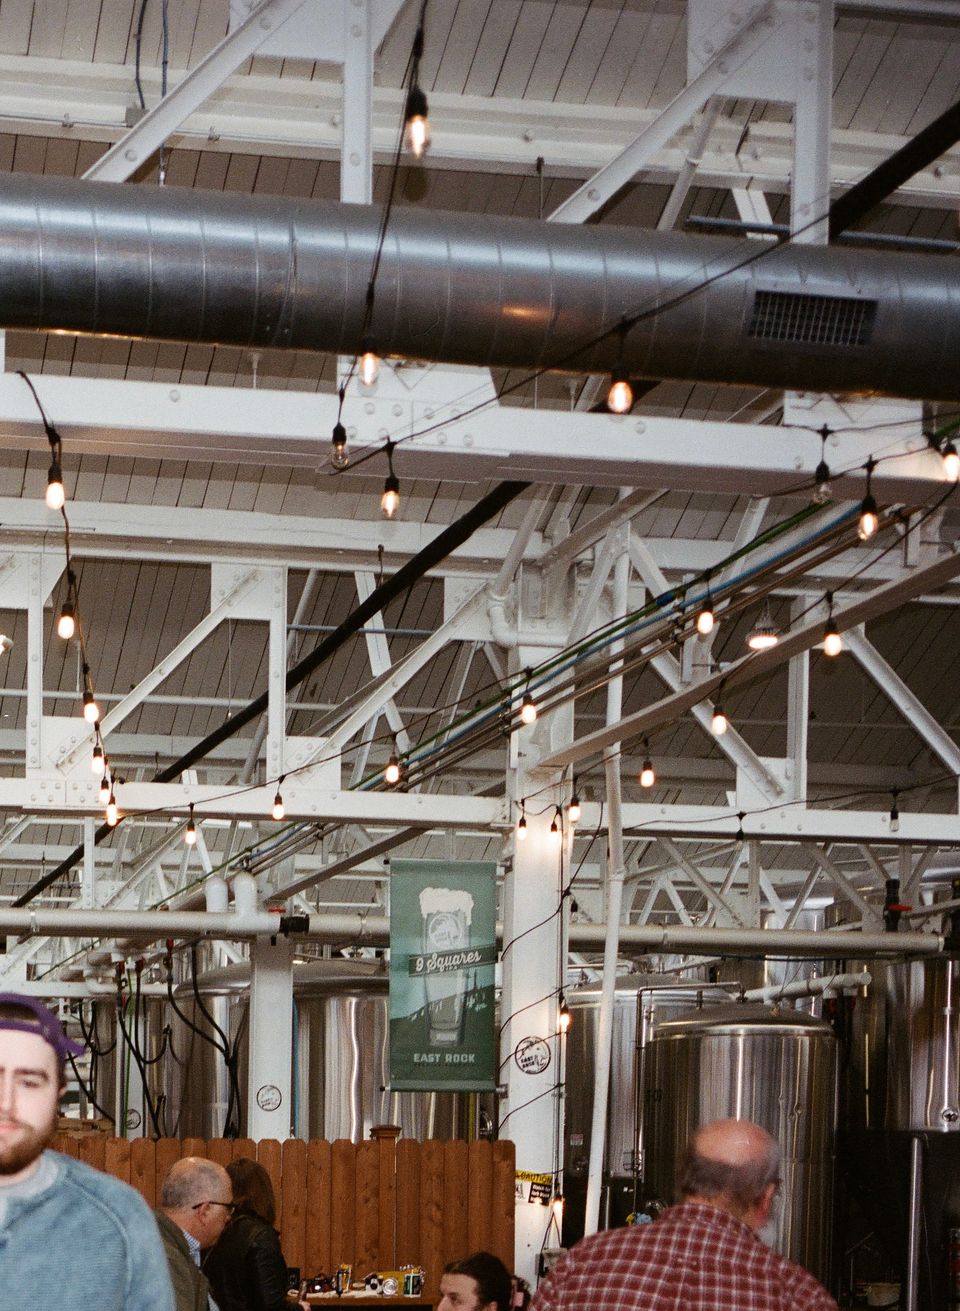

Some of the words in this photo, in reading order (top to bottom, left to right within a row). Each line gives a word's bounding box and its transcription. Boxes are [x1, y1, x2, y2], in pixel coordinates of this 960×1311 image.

[415, 957, 424, 972] 9
[426, 950, 482, 973] Squares
[413, 1053, 441, 1063] EAST
[445, 1053, 475, 1063] ROCK
[521, 1171, 552, 1184] CAUTION
